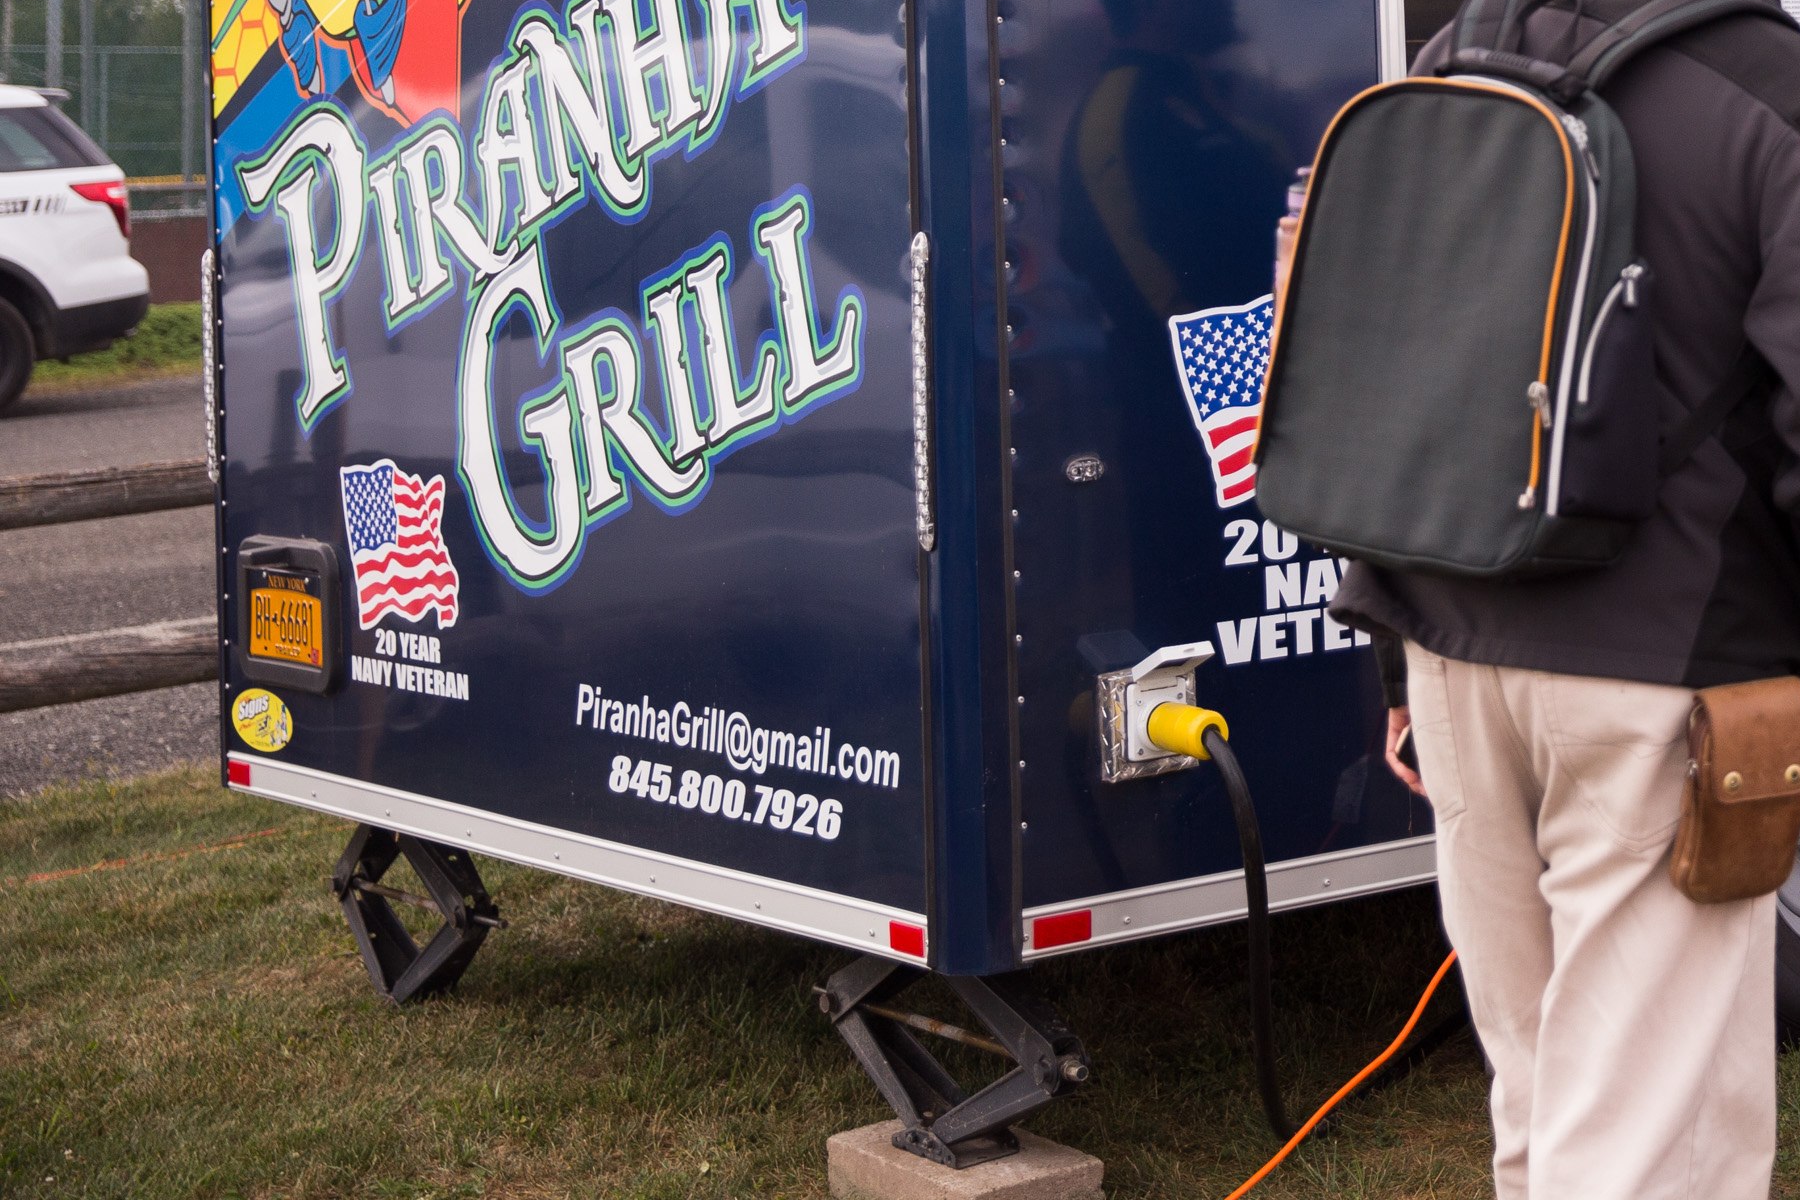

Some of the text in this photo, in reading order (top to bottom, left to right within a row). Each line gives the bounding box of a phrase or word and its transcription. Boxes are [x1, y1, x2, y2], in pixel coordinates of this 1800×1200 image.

[458, 196, 862, 590] GRILL
[267, 574, 306, 592] NEW YORK
[375, 629, 441, 663] 20 YEAR
[351, 656, 469, 701] NAVY VETERAN
[238, 694, 269, 720] Signs
[577, 684, 900, 788] PiranhaGrill@gmail.com
[608, 756, 843, 840] 845.800.7926
